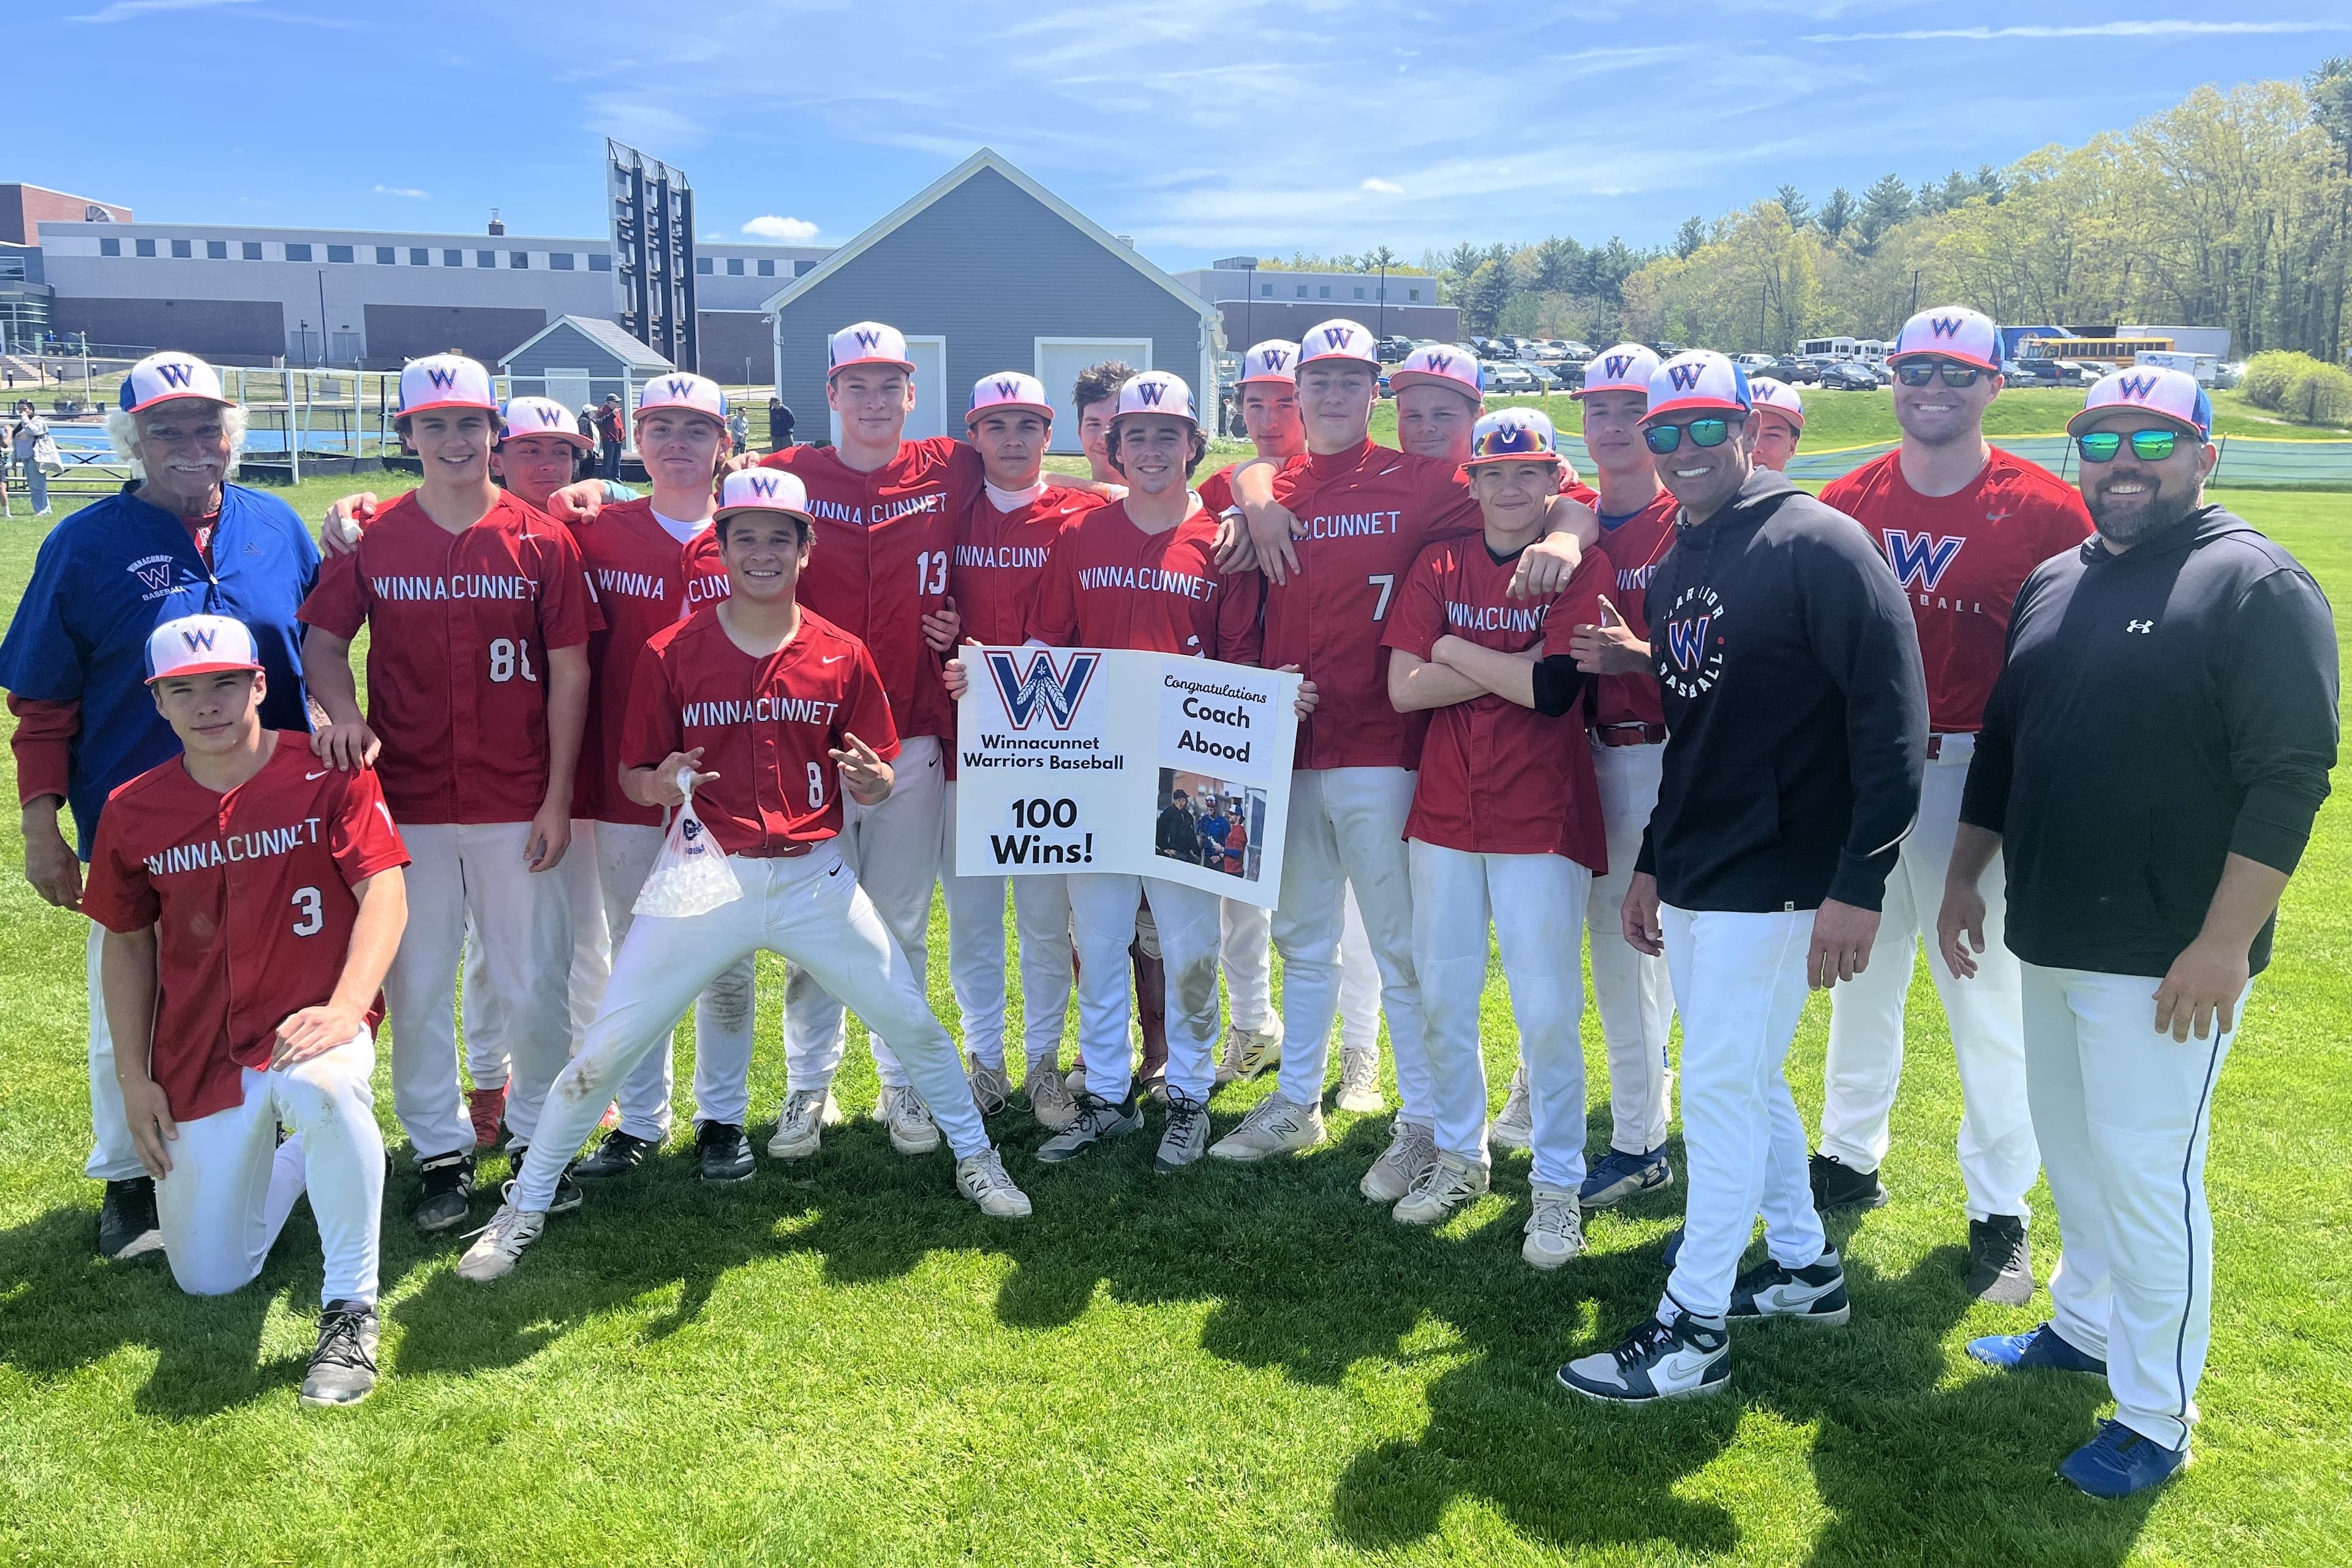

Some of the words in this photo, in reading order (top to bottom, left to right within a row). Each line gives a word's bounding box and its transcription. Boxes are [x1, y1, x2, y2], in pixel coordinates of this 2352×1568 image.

[853, 330, 881, 349] W
[1323, 327, 1354, 349] W
[1931, 315, 1964, 339] W
[1261, 350, 1289, 371] W
[1427, 353, 1453, 373] W
[1604, 354, 1635, 379] W
[156, 363, 194, 388] W
[428, 367, 458, 390] W
[1668, 363, 1706, 391] W
[2117, 373, 2160, 401] W
[667, 379, 695, 398] W
[994, 380, 1021, 400] W
[1137, 382, 1168, 405] W
[1751, 383, 1777, 401] W
[535, 407, 560, 427] W
[748, 476, 780, 498] W
[917, 551, 948, 594] 13
[1882, 528, 1967, 592] W
[137, 564, 169, 589] W
[371, 575, 538, 601] WINNACUNNET
[1079, 566, 1218, 602] WINNACUNNET
[142, 586, 186, 601] BASEBALL
[1368, 573, 1394, 621] 7
[182, 627, 217, 653] W
[1669, 614, 1712, 672] W
[983, 650, 1102, 731] W
[1164, 675, 1267, 704] Congratulations
[683, 697, 839, 727] WINNACUNNET
[1182, 698, 1251, 729] Coach
[981, 734, 1100, 750] Winnacunnet
[1177, 729, 1251, 763] Abood
[963, 753, 1044, 768] Warriors
[1050, 755, 1124, 771] Baseball
[807, 761, 824, 809] 8
[1011, 798, 1077, 829] 100
[990, 832, 1093, 865] Wins!
[292, 886, 324, 937] 3
